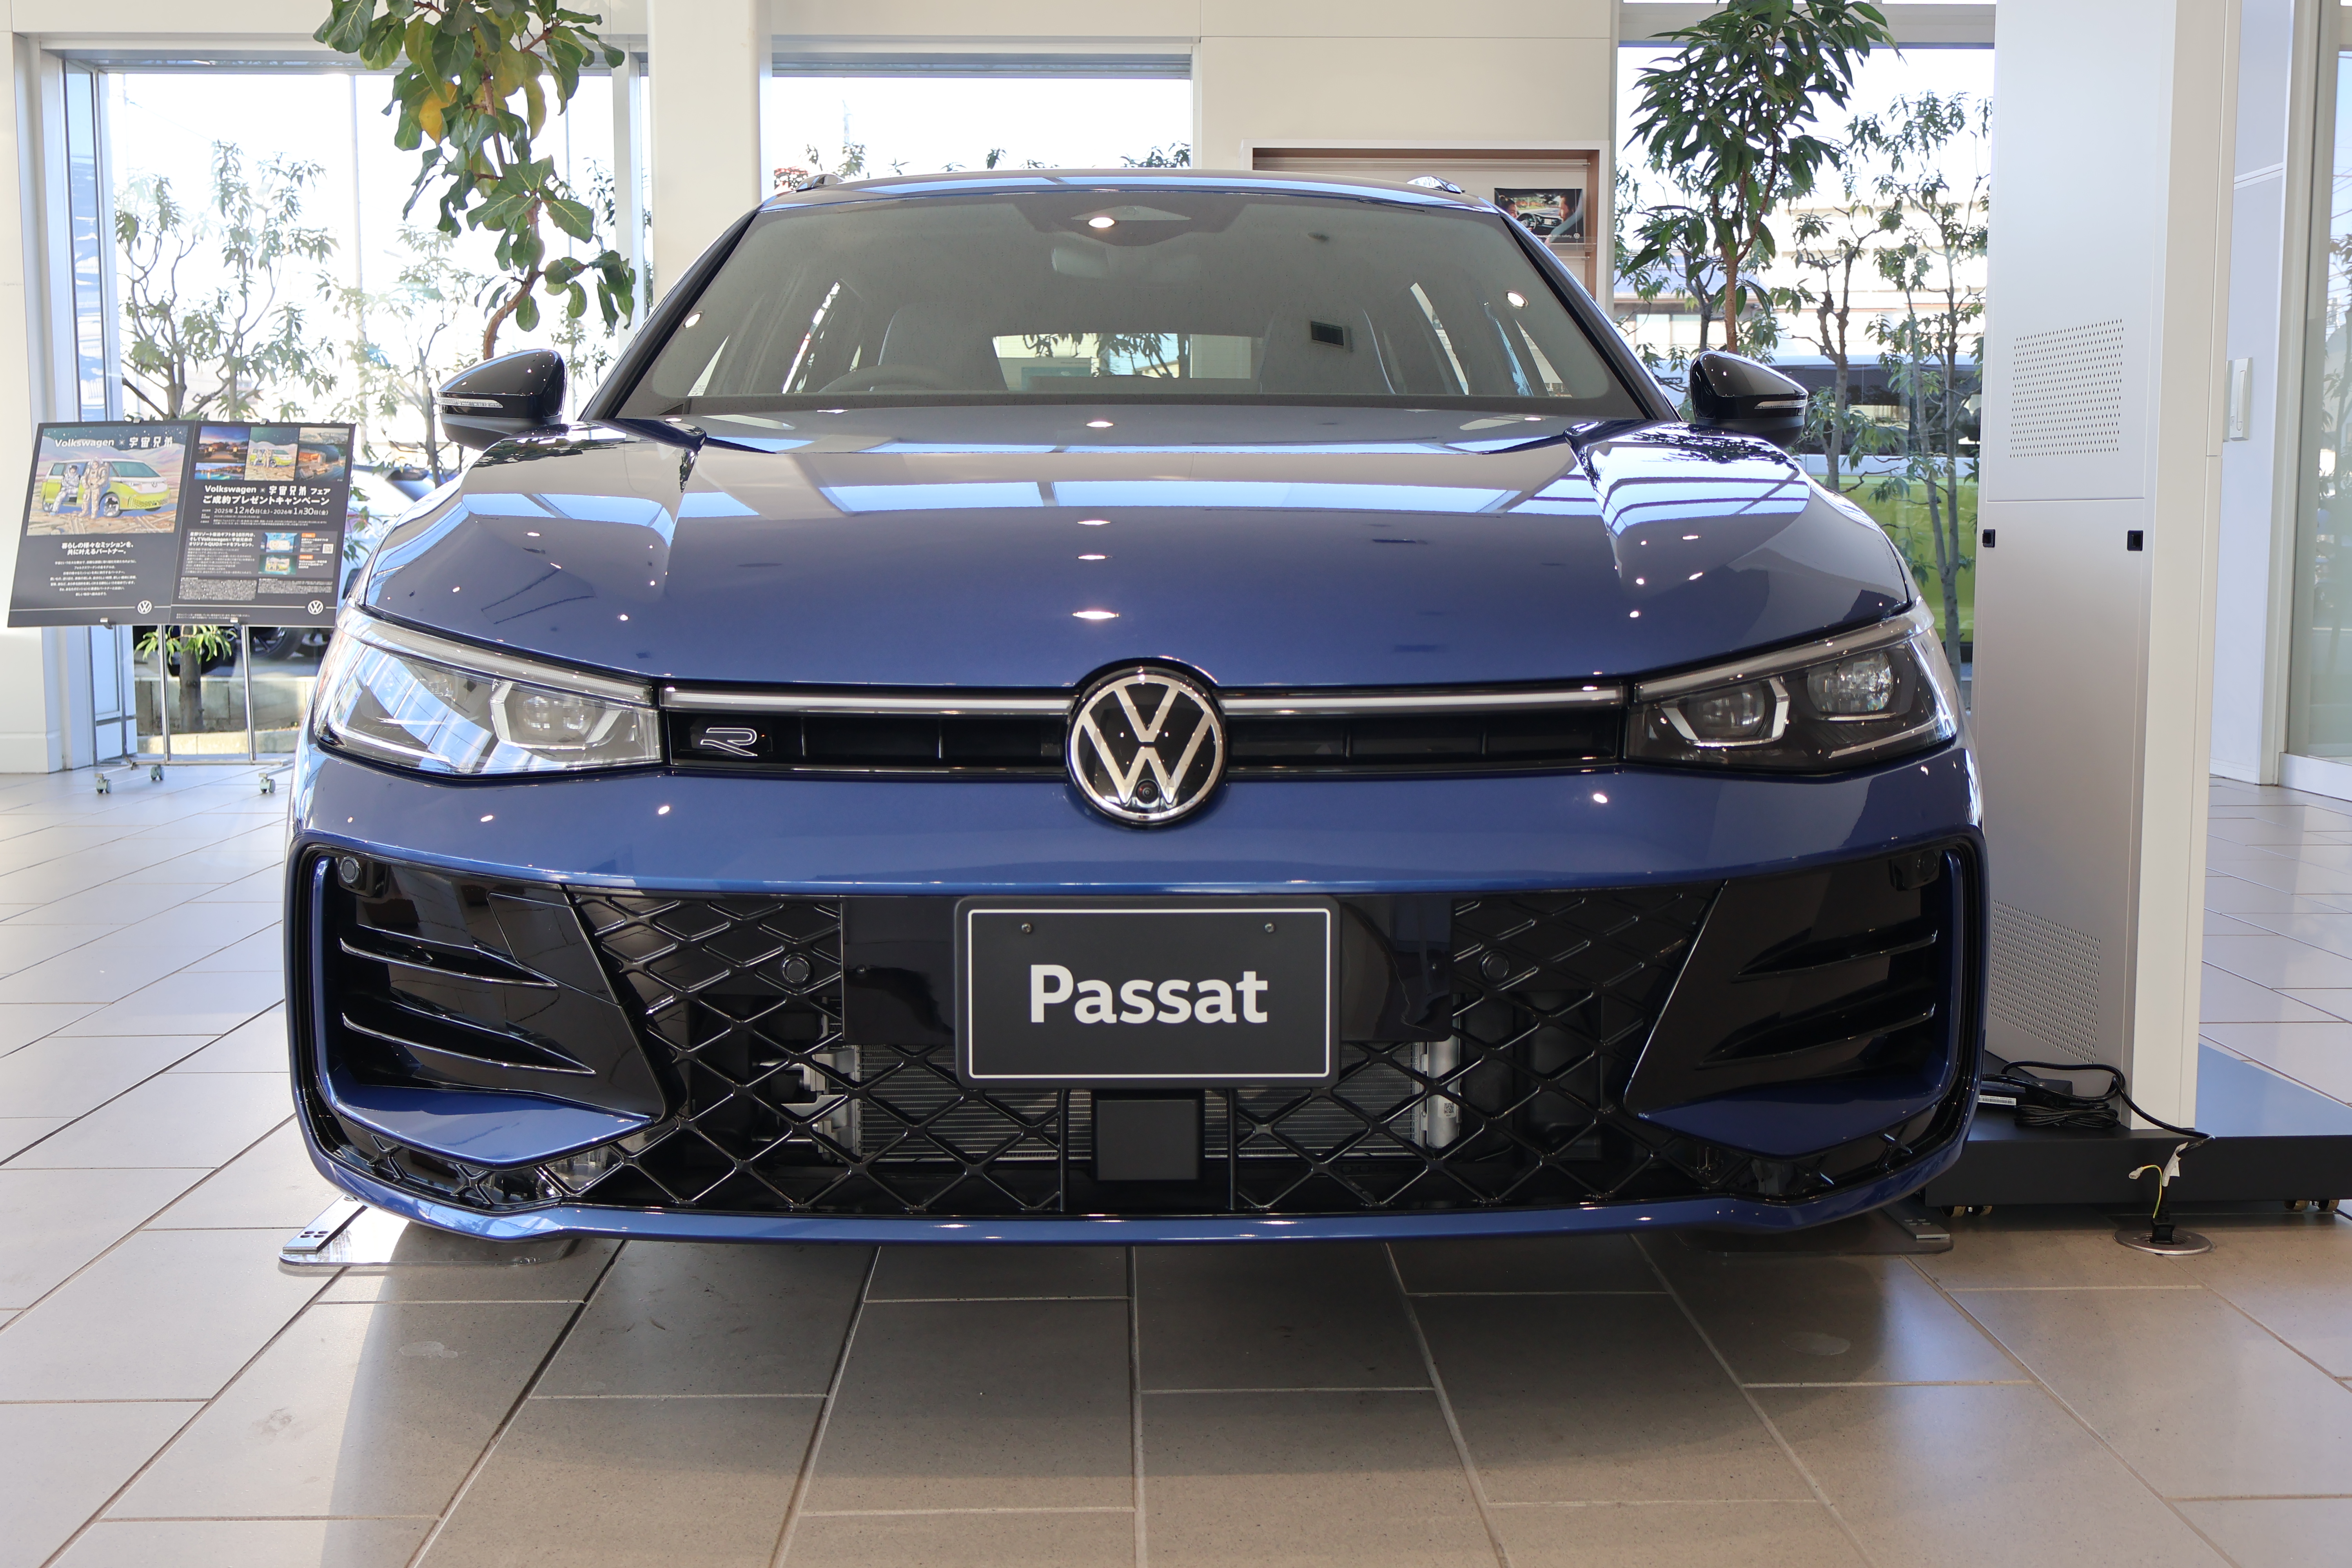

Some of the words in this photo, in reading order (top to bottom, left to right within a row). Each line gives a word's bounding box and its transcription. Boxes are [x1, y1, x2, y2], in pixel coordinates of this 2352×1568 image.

[55, 439, 114, 448] Volkswagen
[129, 436, 172, 448] 宇宙兄弟
[203, 495, 330, 505] ご成約プレゼントキャンペーン
[205, 485, 256, 494] Volkswagen
[269, 485, 307, 496] 宇宙兄弟
[701, 728, 758, 756] R
[1071, 675, 1223, 819] VW
[1031, 964, 1268, 1024] Passat
